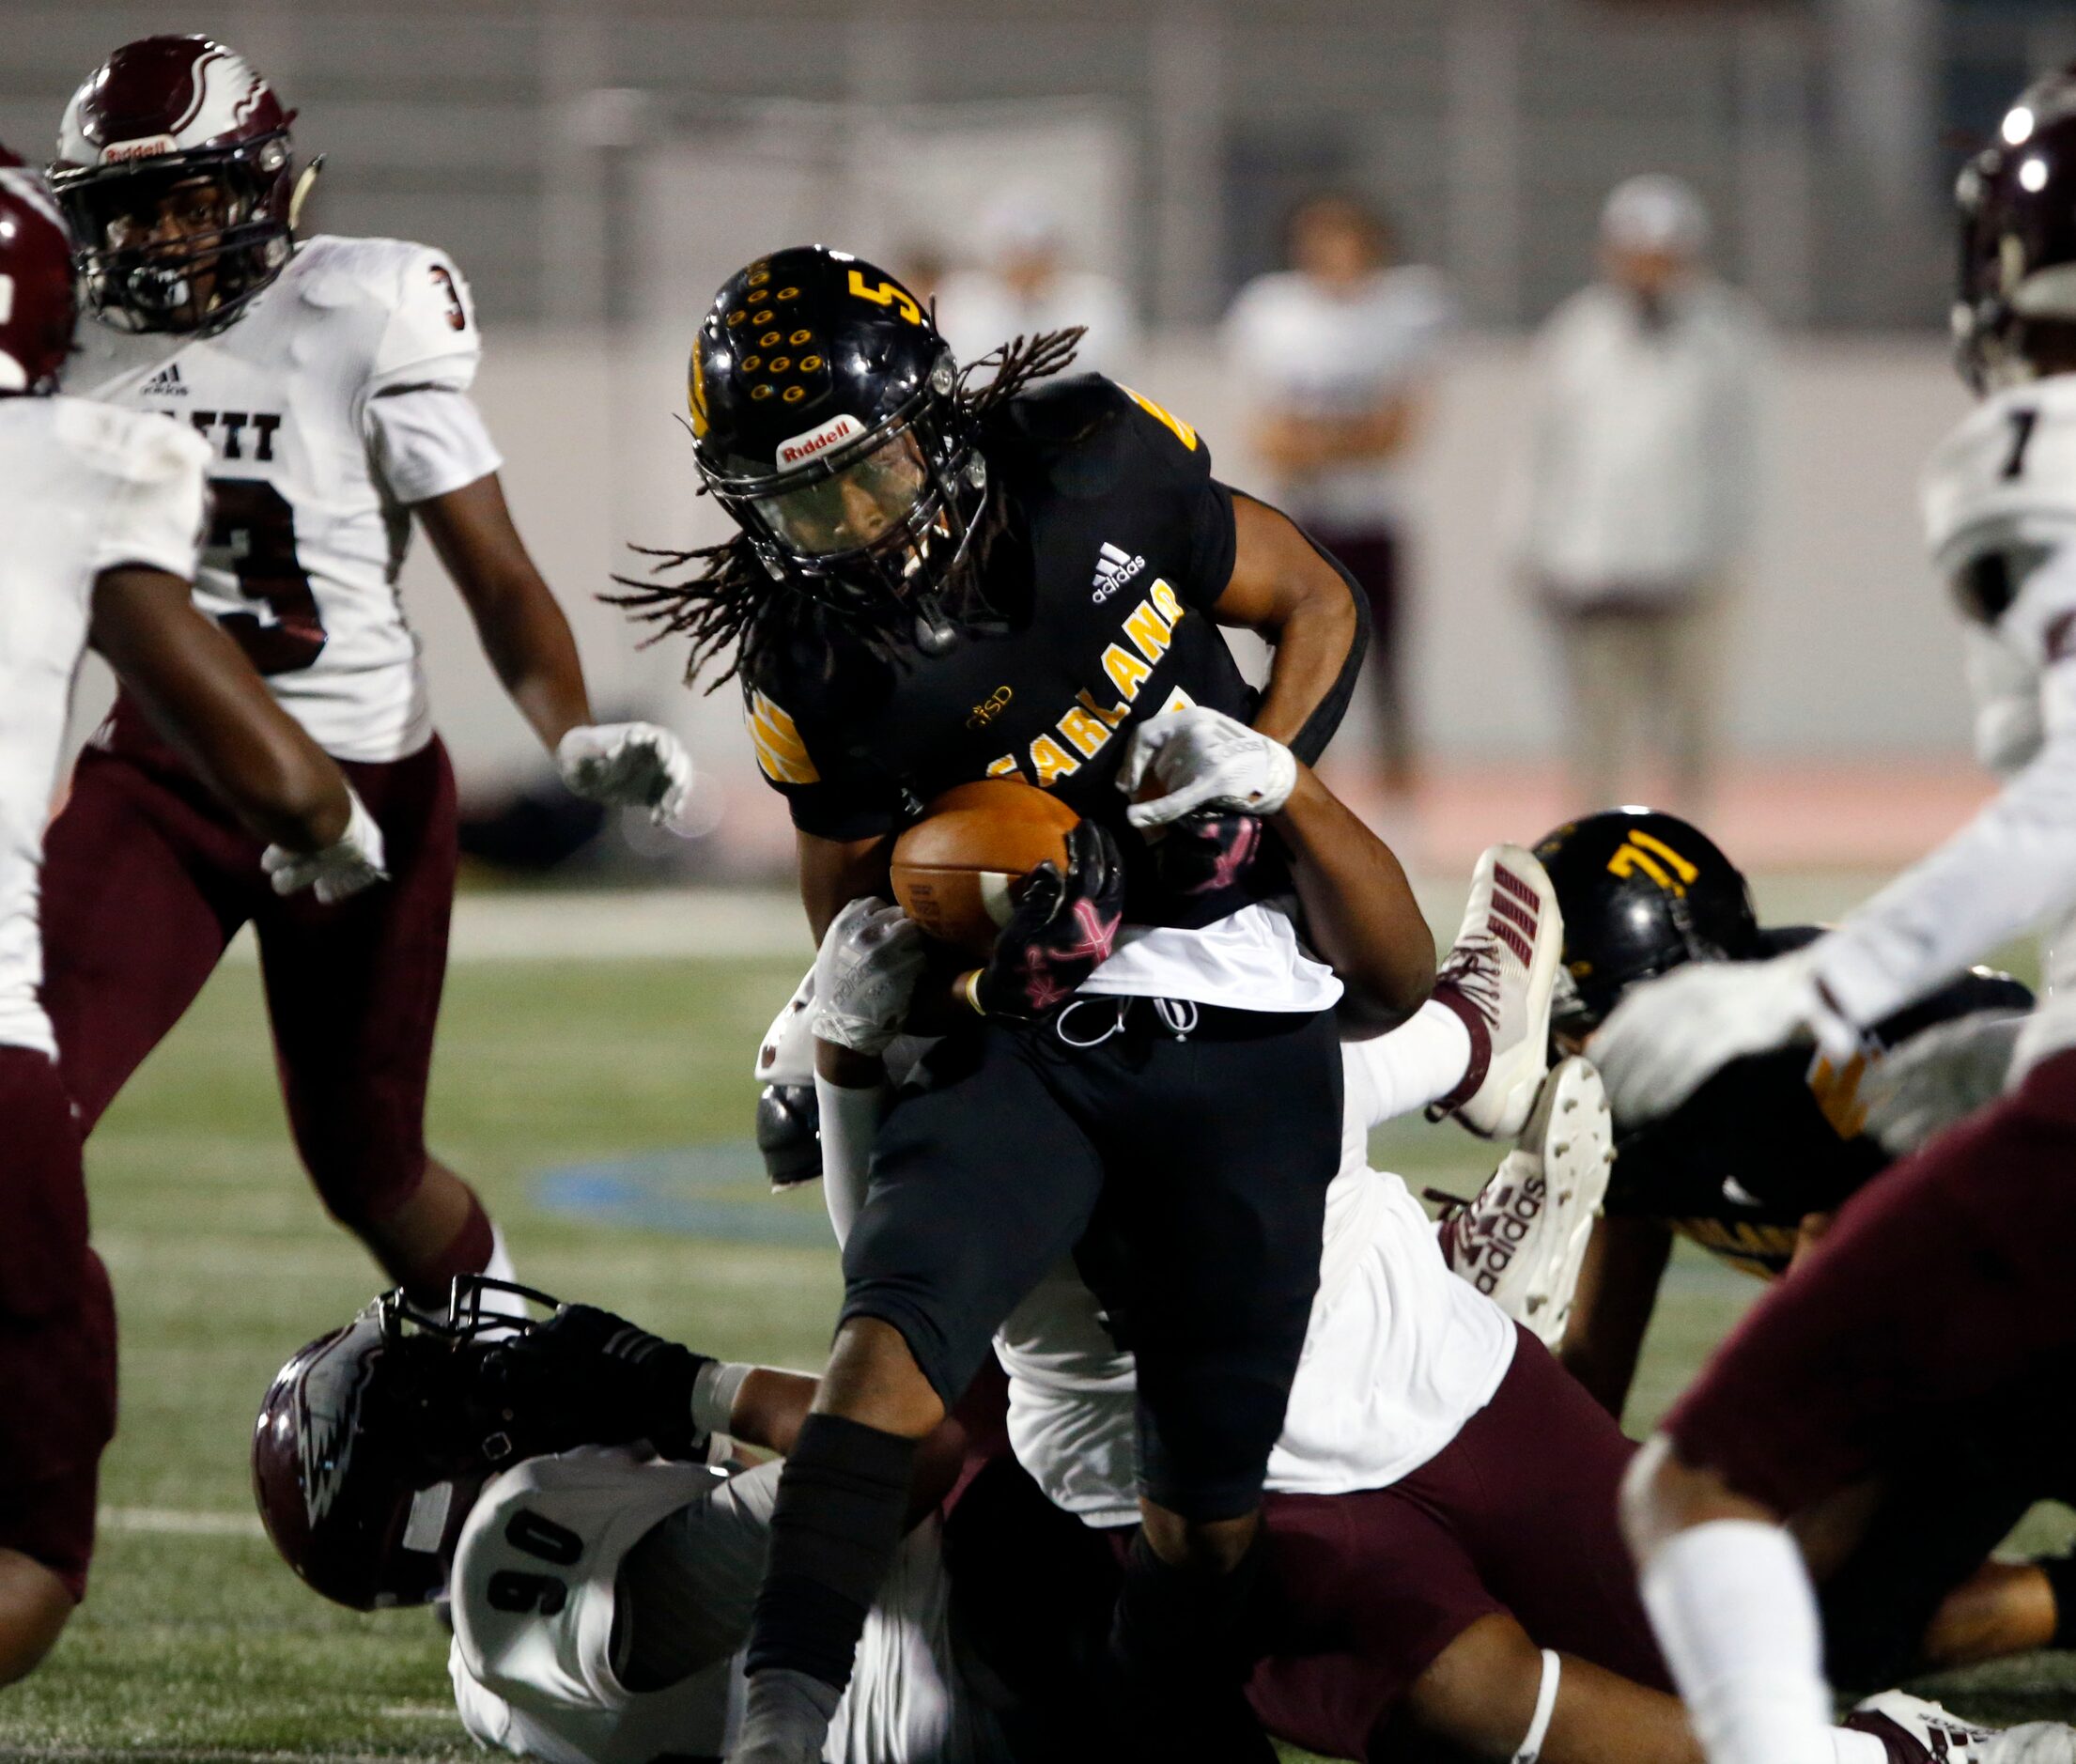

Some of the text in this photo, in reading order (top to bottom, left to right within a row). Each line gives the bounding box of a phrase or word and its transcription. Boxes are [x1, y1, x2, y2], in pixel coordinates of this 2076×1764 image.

[428, 264, 466, 332] 3
[847, 269, 922, 326] 5
[161, 410, 281, 460] TT
[782, 421, 850, 463] Riddell
[1092, 554, 1146, 604] adidas
[1607, 828, 1699, 900] 71
[1475, 1176, 1547, 1295] adidas
[487, 1509, 584, 1617] 90
